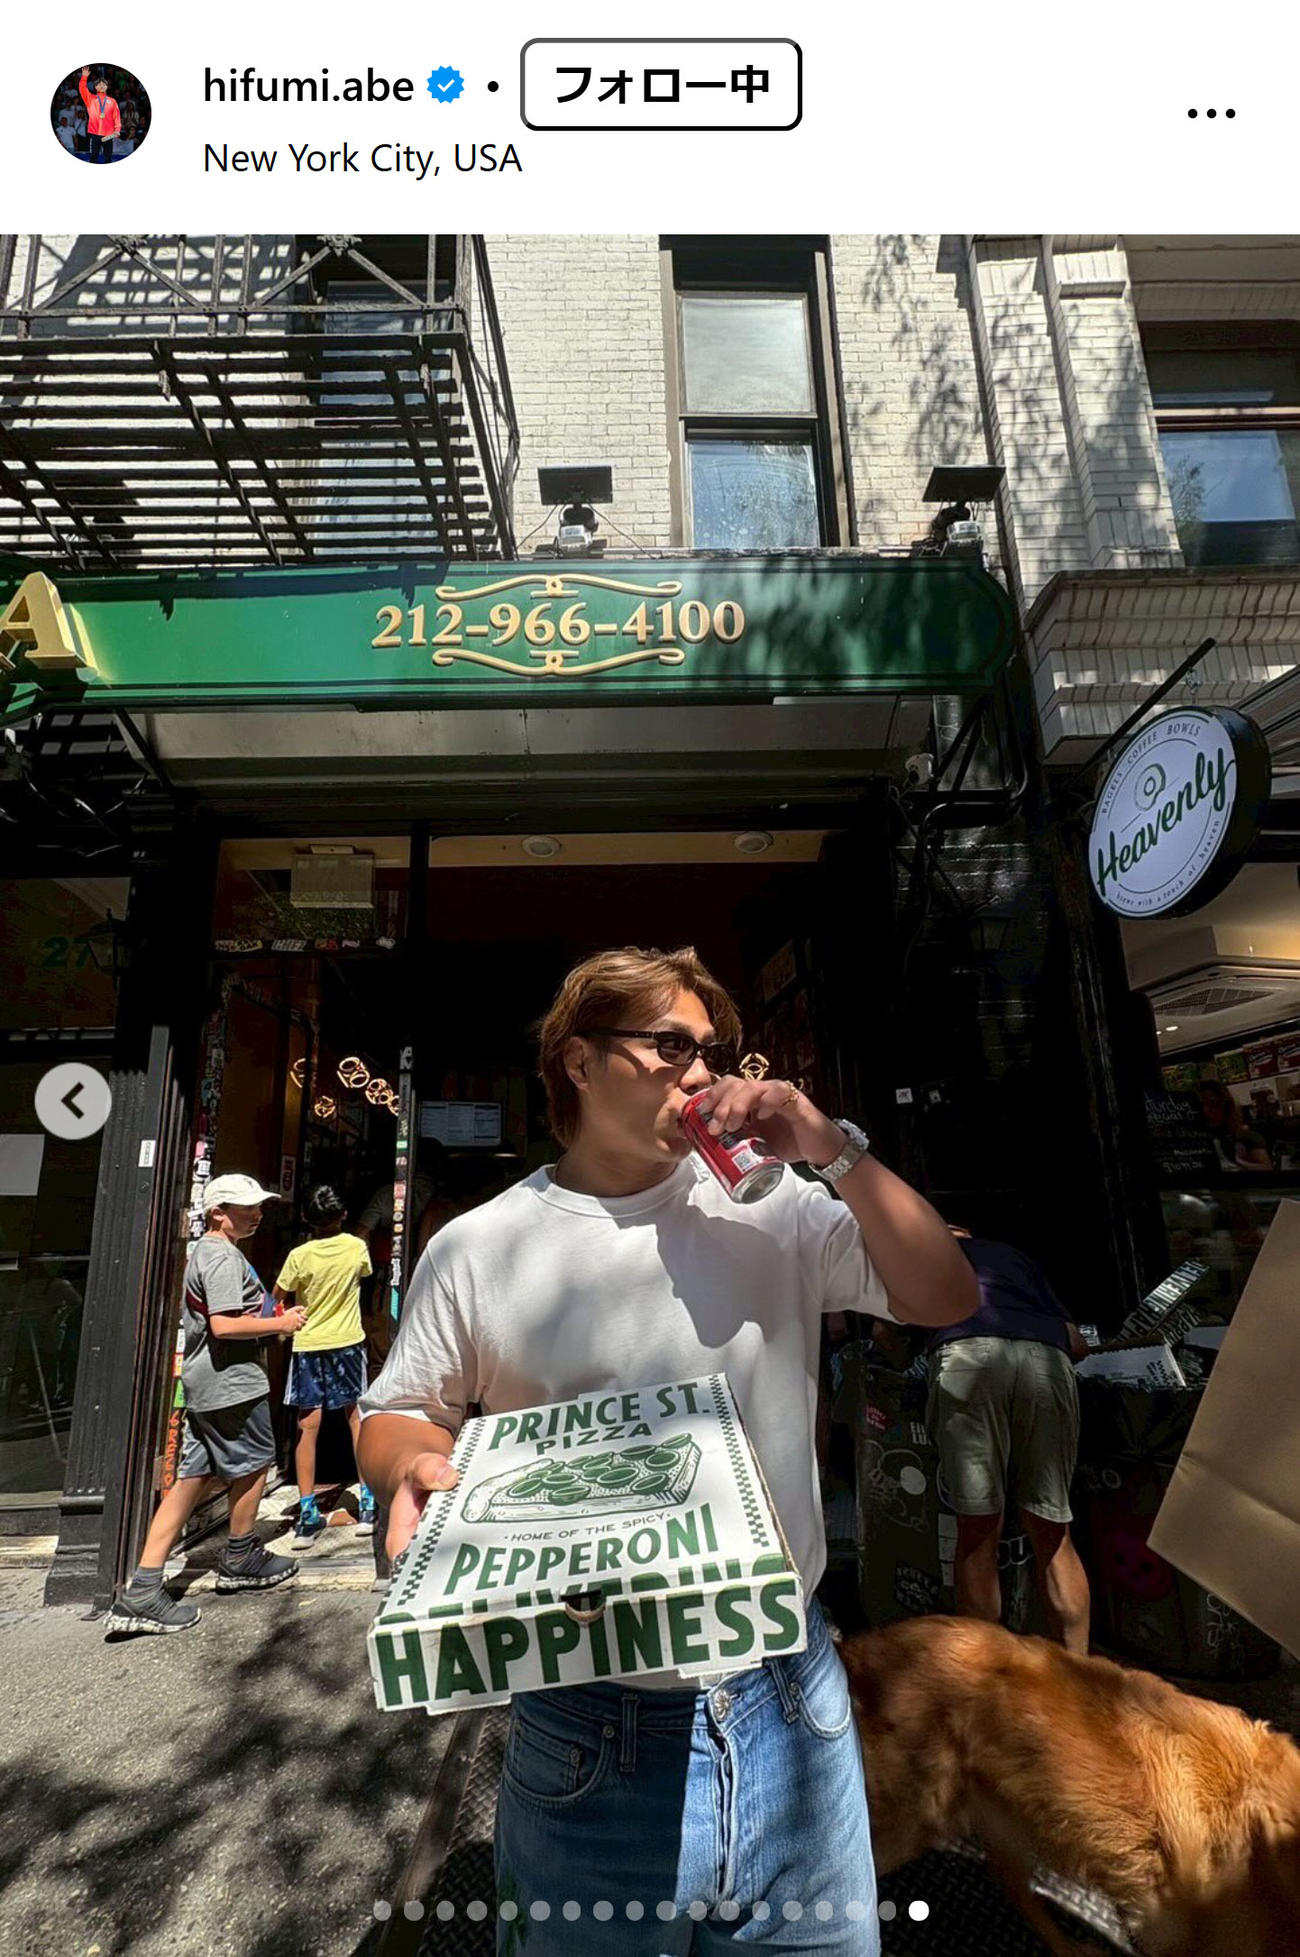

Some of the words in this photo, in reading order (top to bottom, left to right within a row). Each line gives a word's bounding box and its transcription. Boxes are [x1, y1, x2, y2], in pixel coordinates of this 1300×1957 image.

[371, 602, 746, 647] 212-966-4100
[1127, 731, 1158, 764] COFFEE
[1167, 723, 1201, 737] BOWLS
[1097, 747, 1235, 897] Heavenly
[487, 1392, 641, 1451] PRINCE
[656, 1382, 710, 1418] ST.
[535, 1423, 653, 1456] PIZZA
[443, 1502, 720, 1596] PEPPERONI
[510, 1531, 553, 1542] HOME
[558, 1529, 579, 1539] OF
[584, 1523, 616, 1535] THE
[622, 1512, 666, 1529] SPICY
[375, 1578, 801, 1707] HAPPINESS
